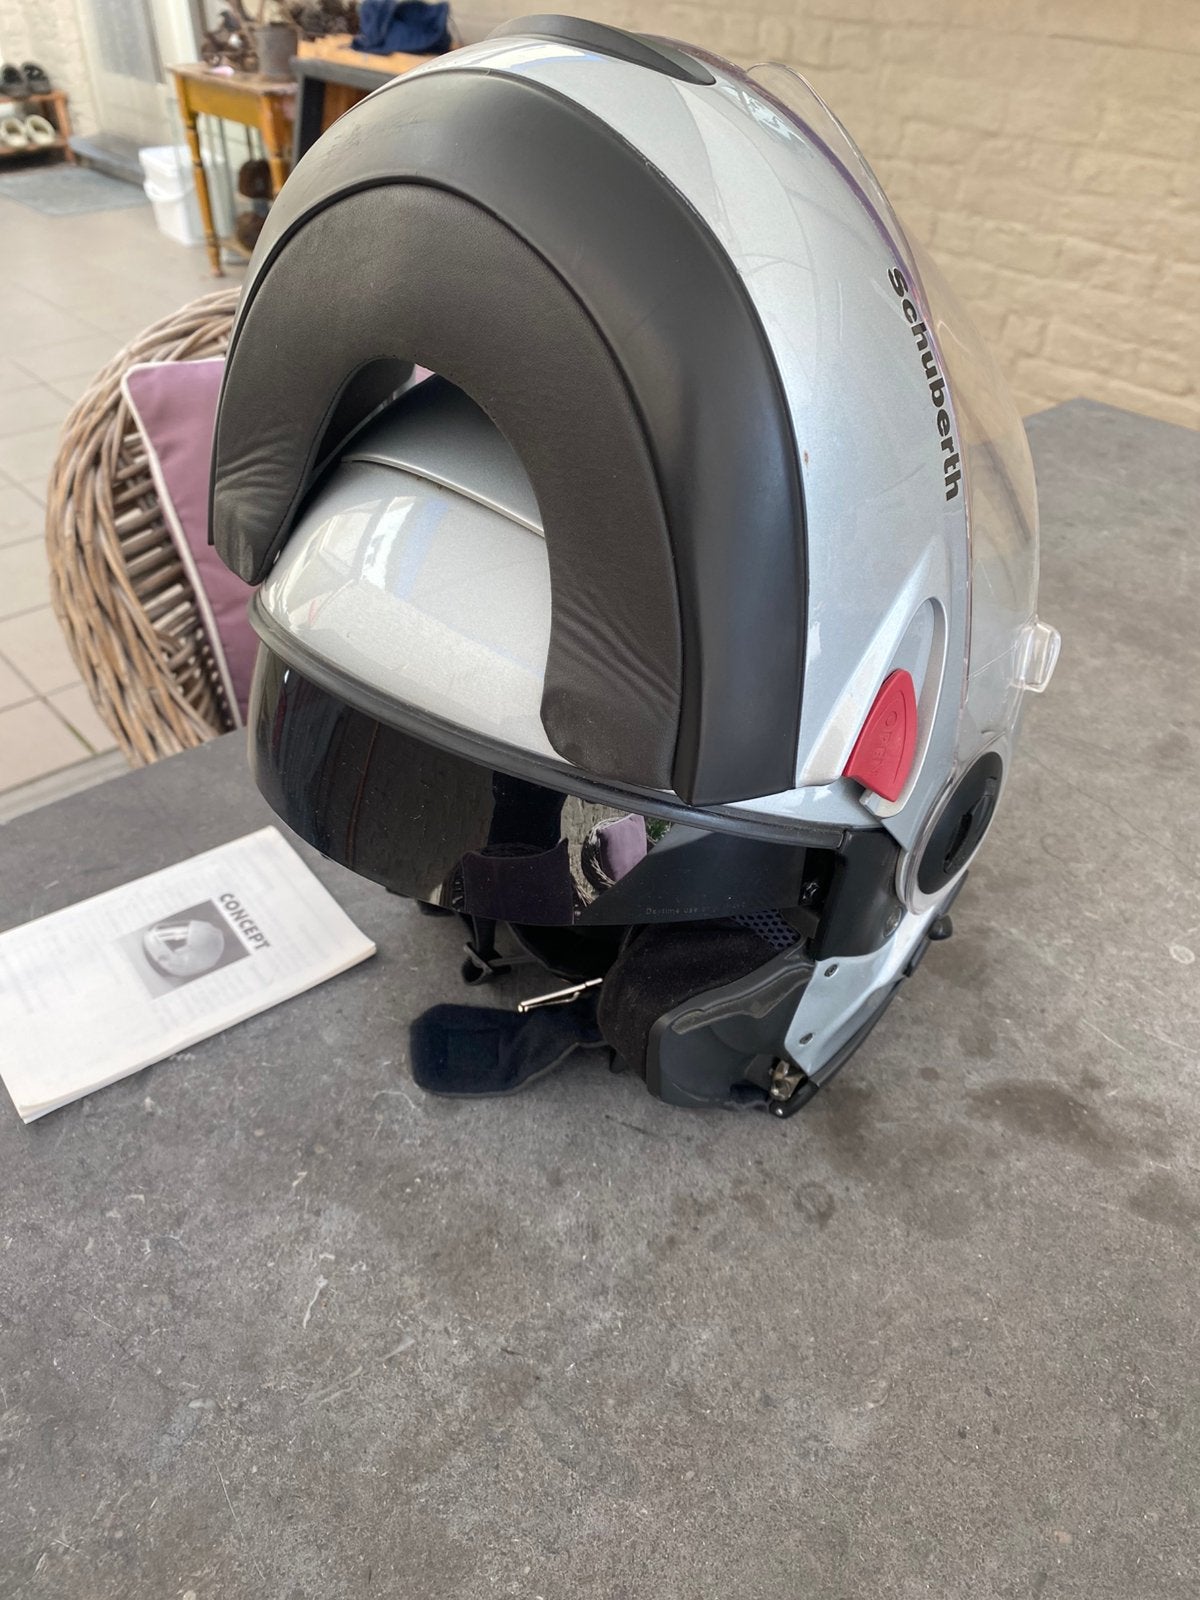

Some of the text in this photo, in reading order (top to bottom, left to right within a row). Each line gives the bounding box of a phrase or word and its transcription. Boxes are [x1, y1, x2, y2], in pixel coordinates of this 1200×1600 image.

[887, 267, 962, 501] Schuberth
[872, 710, 898, 776] OPEN
[219, 893, 270, 950] CONCEPT
